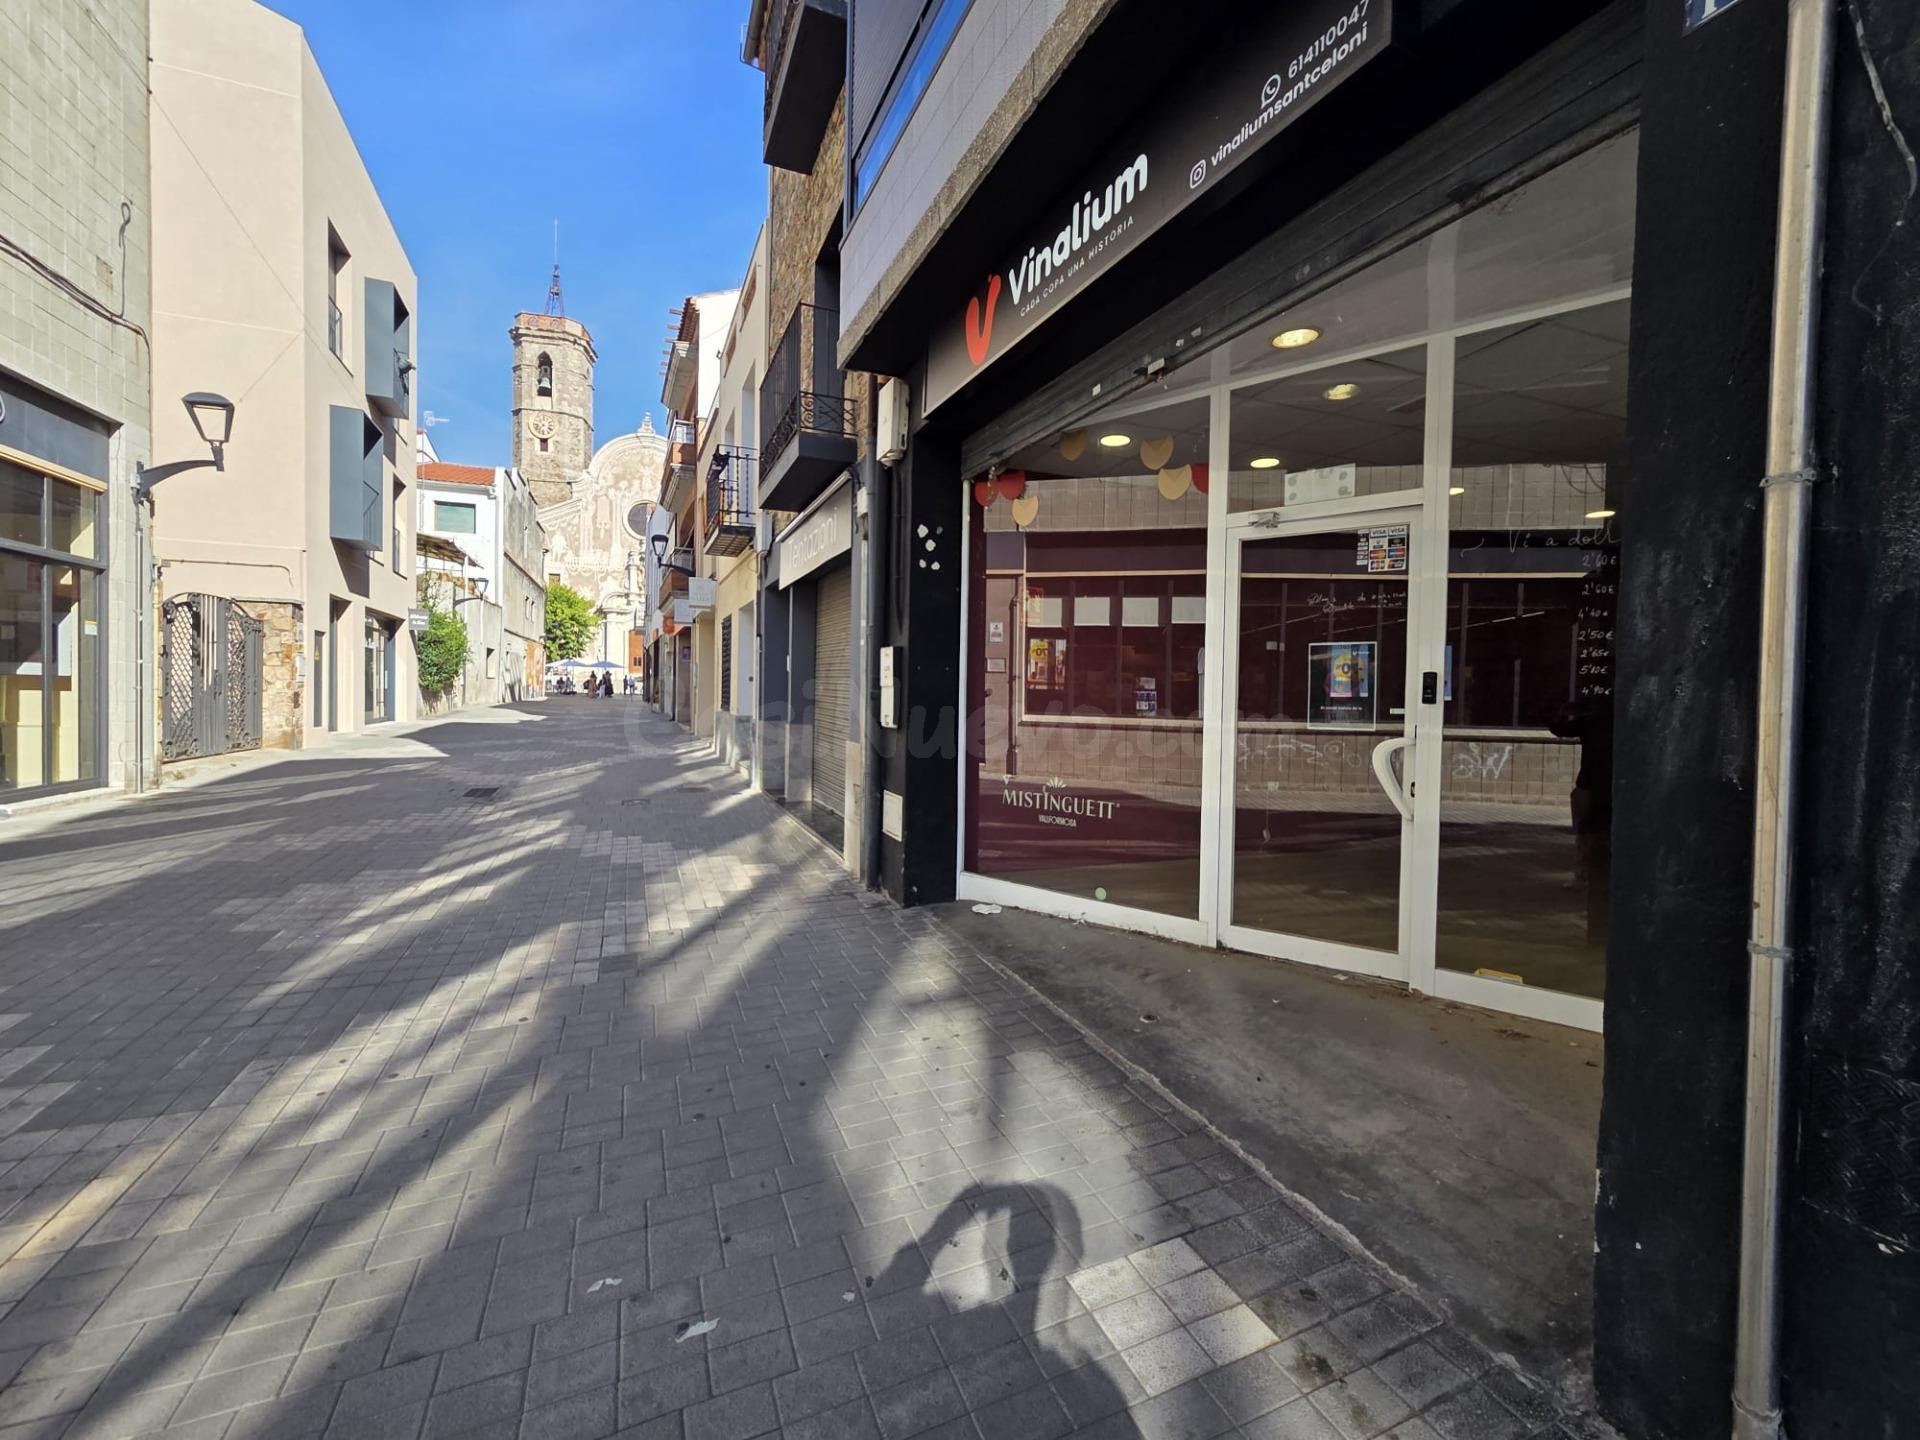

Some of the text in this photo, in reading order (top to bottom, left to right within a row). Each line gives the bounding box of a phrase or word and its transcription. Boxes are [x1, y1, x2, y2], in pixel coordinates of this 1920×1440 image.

[1288, 0, 1369, 78] 614110047
[1211, 21, 1368, 166] vinaliumsantceloni
[1008, 153, 1148, 305] Vinalium
[1020, 215, 1134, 317] CADA COPA UNA HISTORIA
[1002, 786, 1115, 819] MISTINGUETT
